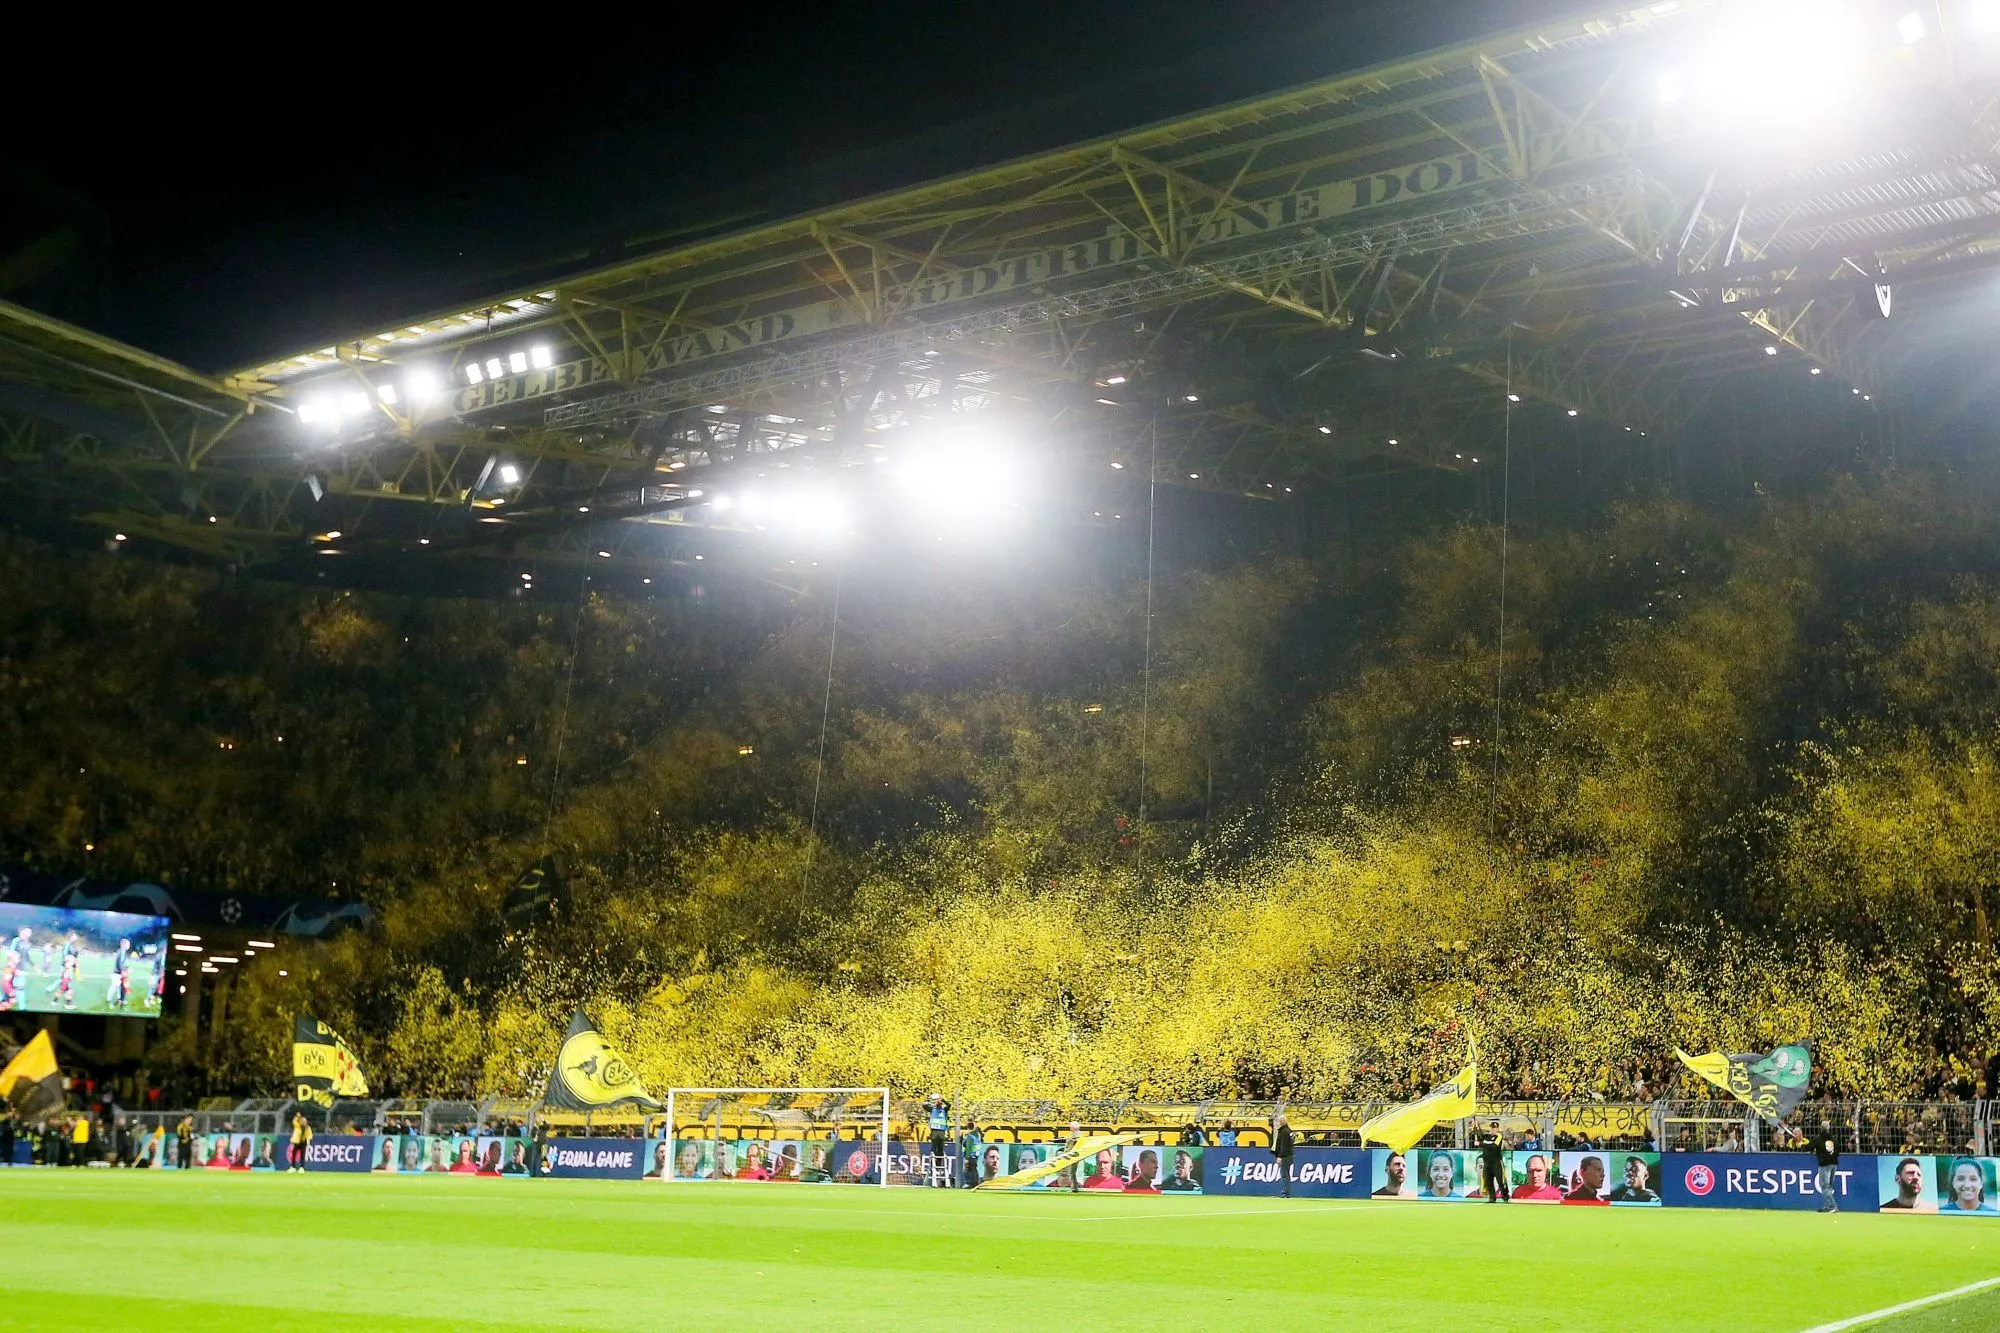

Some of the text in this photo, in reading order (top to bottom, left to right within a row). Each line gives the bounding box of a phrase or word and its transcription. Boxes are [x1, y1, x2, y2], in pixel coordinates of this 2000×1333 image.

[640, 313, 796, 370] WAND
[304, 1144, 364, 1163] RESPECT
[875, 1153, 958, 1175] RESPET
